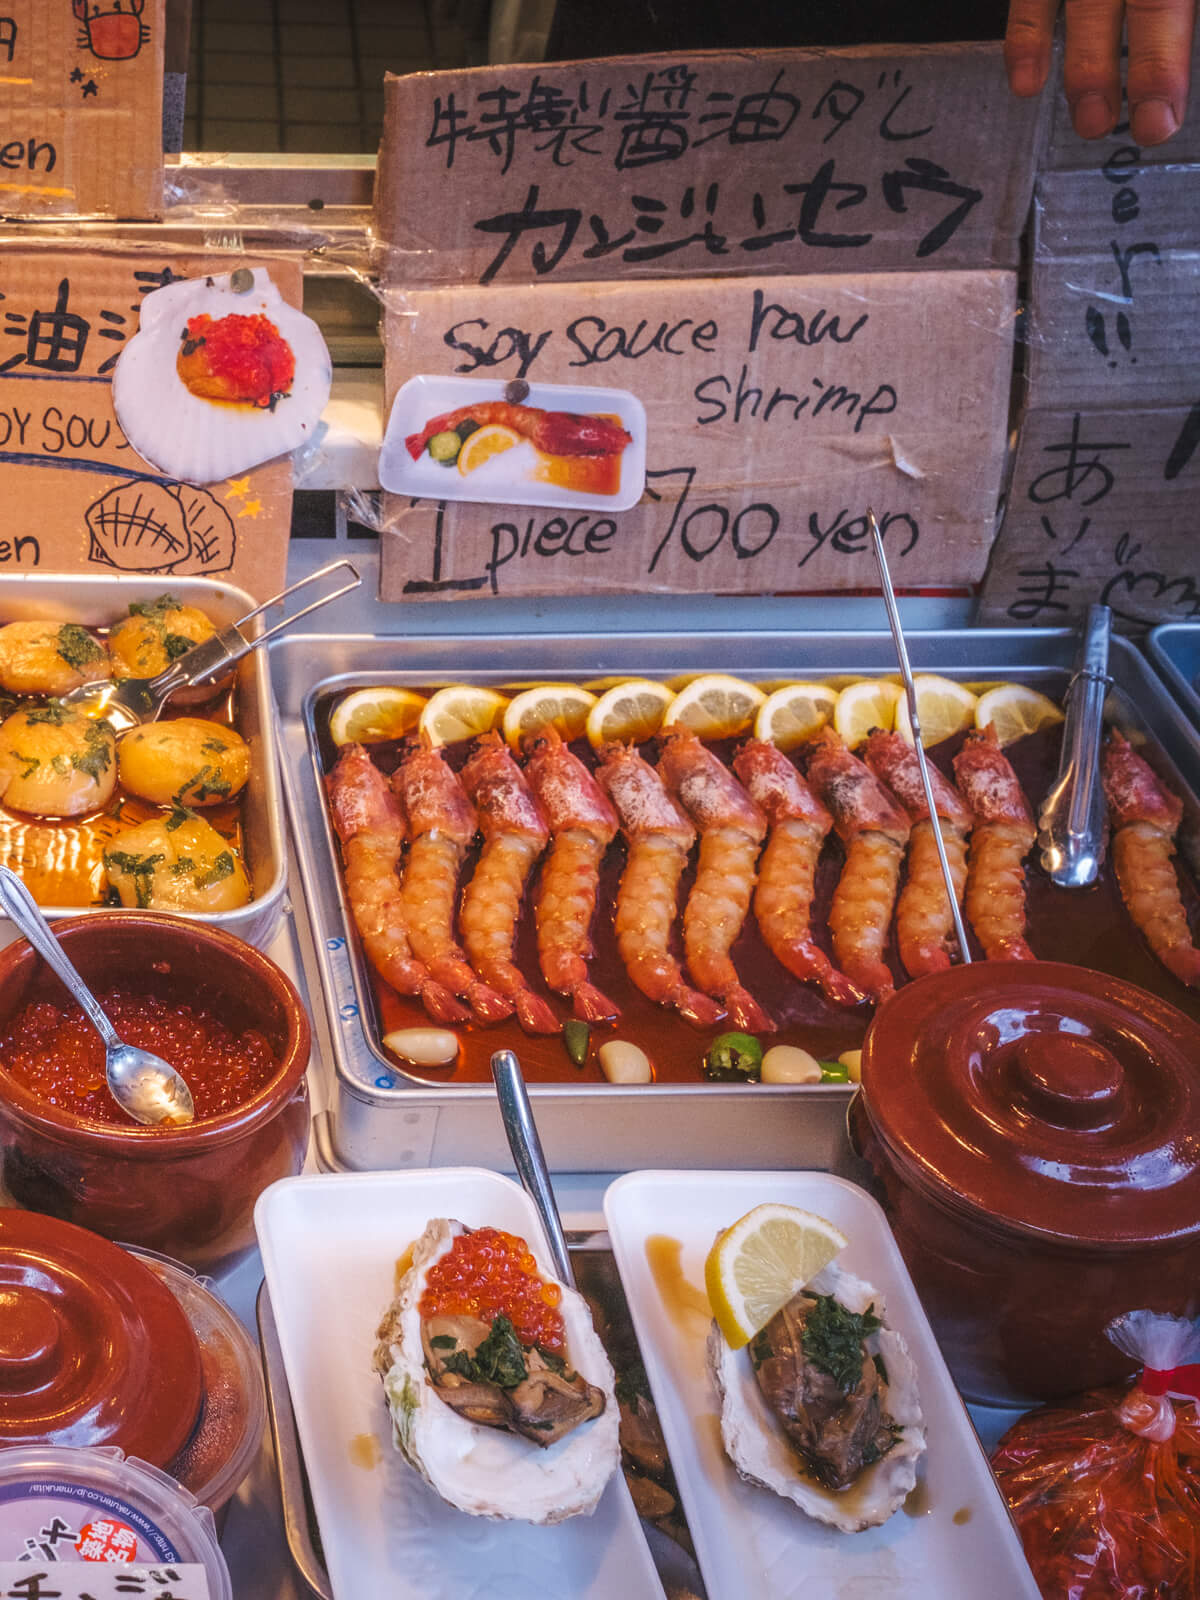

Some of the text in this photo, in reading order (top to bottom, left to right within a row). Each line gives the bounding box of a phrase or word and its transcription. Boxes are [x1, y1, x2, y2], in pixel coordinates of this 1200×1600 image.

[41, 406, 131, 453] SOU
[486, 514, 618, 595] piece
[645, 466, 781, 573] 700
[798, 506, 921, 568] yen
